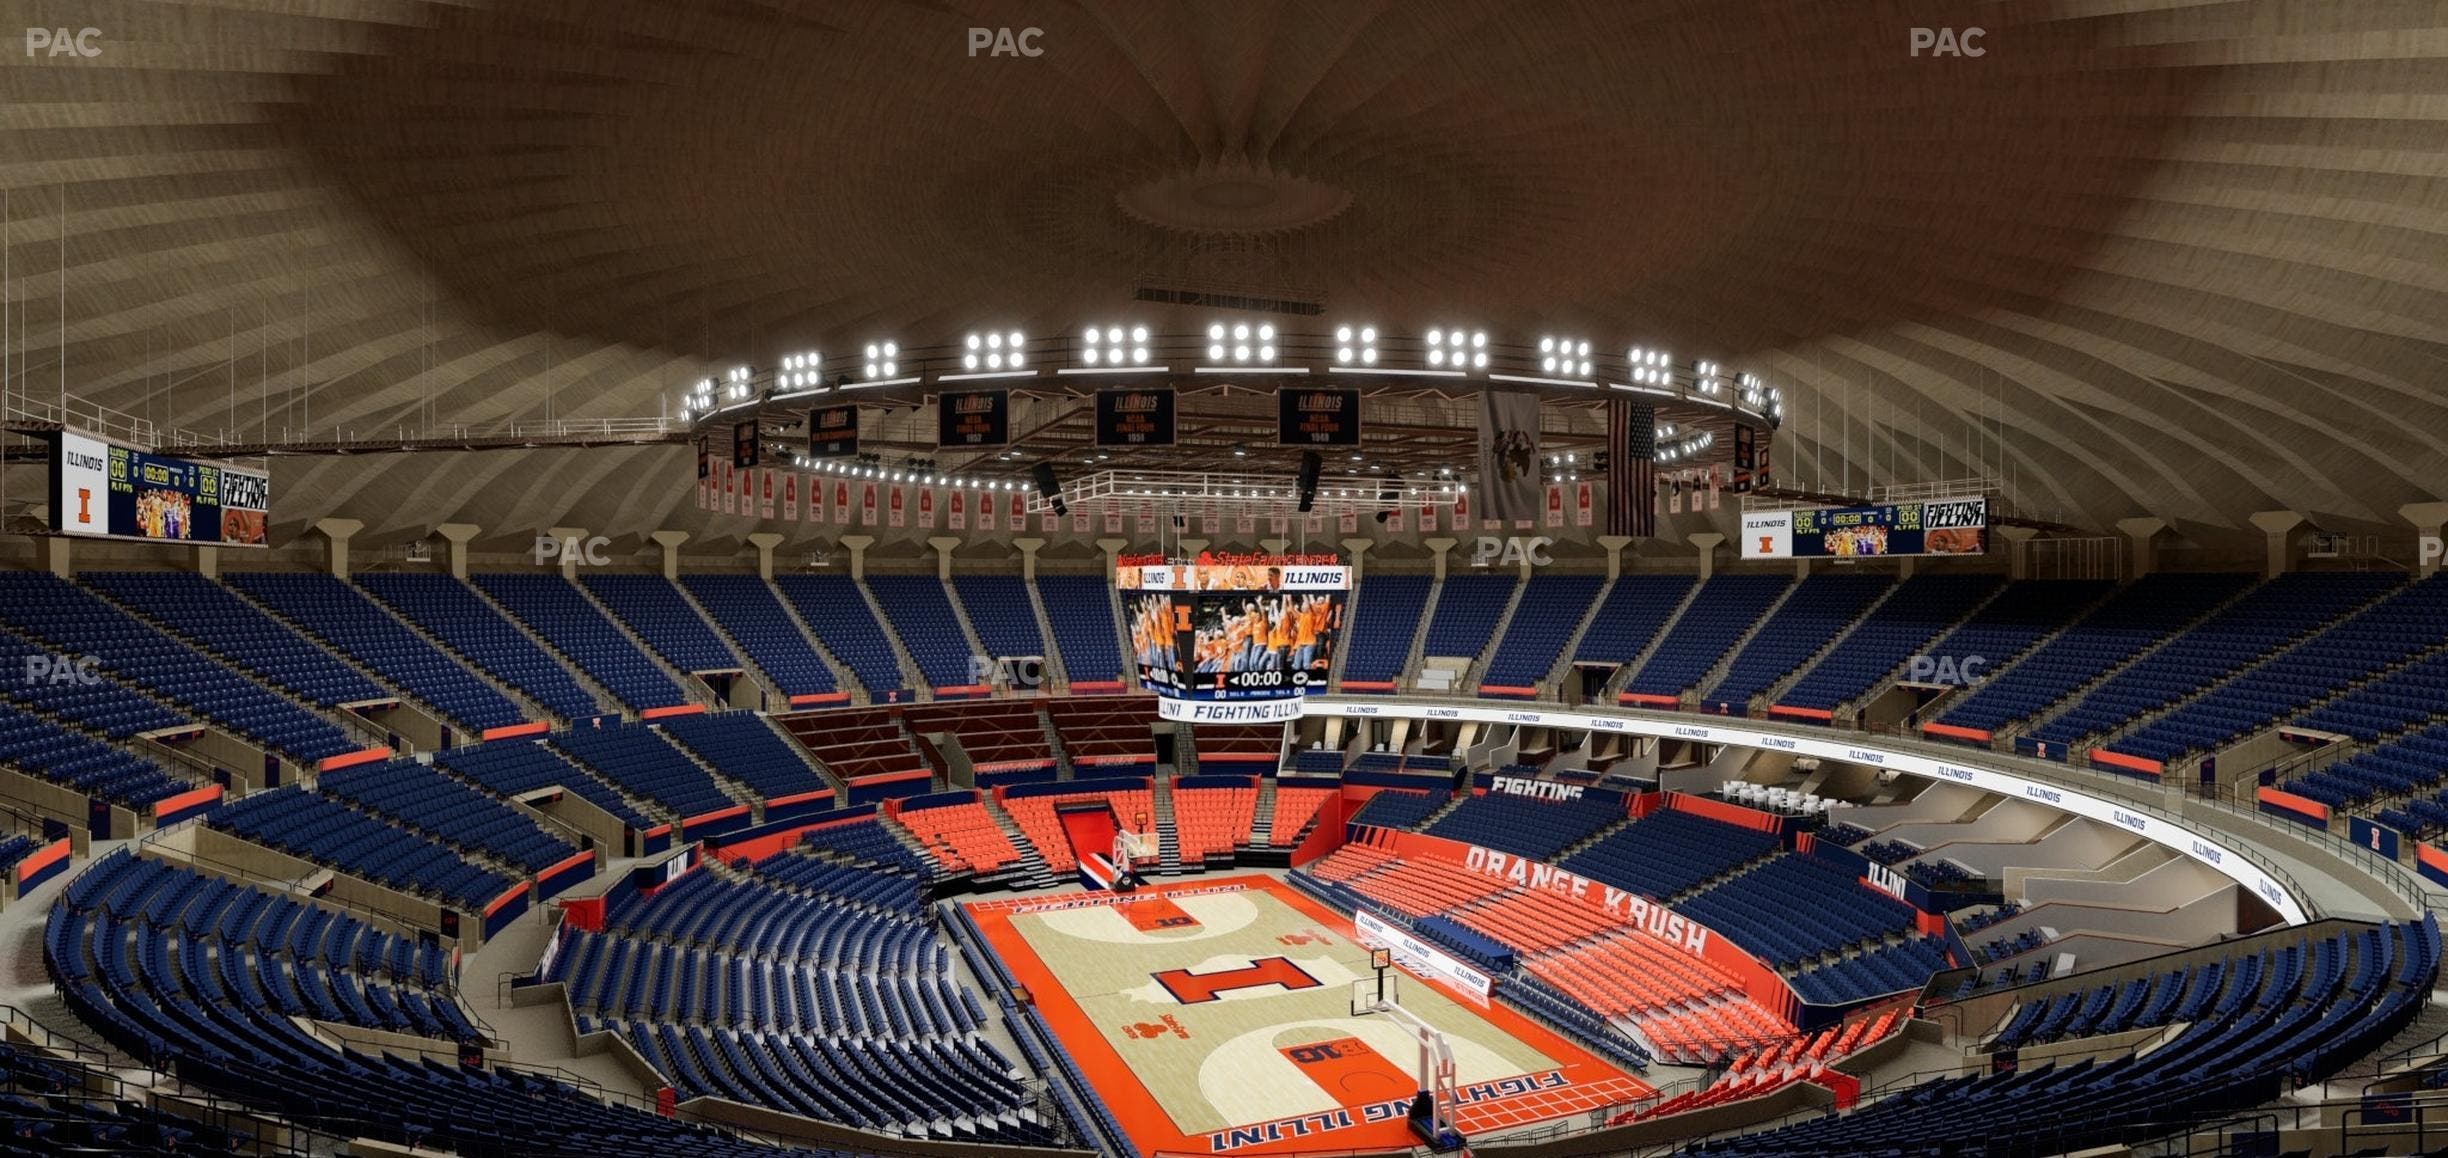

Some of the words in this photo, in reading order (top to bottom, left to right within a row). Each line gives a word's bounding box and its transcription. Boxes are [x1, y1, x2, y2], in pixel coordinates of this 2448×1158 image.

[1114, 396, 1157, 408] ILLINOIS
[1298, 396, 1342, 408] ILLINOIS
[66, 451, 104, 472] ILLINOIS
[111, 459, 125, 479] 00
[145, 466, 168, 483] 00:00
[202, 477, 216, 493] 00
[224, 472, 267, 494] FIGHTING
[78, 488, 90, 523] I
[223, 489, 267, 509] ILLINI
[1928, 501, 1984, 516] FIGHTING
[1746, 520, 1787, 529] ILLINOIS
[1796, 517, 1811, 528] 00
[1835, 514, 1860, 524] 00:00
[1901, 512, 1918, 522] 00
[1926, 513, 1984, 528] ILLINI
[1759, 537, 1773, 553] I
[1284, 572, 1342, 584] ILLINOIS
[1175, 605, 1192, 631] I
[1240, 671, 1282, 687] 00:00
[1214, 689, 1226, 699] 00
[1293, 687, 1306, 696] 00
[1194, 705, 1270, 720] FIGHTING
[1346, 706, 1379, 714] ILLINOIS
[1426, 709, 1459, 718] ILLINOIS
[1508, 713, 1541, 722] ILLINOIS
[1591, 719, 1624, 729] ILLINOIS
[1675, 727, 1709, 738] ILLINOIS
[1761, 737, 1796, 750] ILLINOIS
[1848, 750, 1884, 764] ILLINOIS
[1937, 765, 1974, 781] ILLINOIS
[1492, 776, 1584, 801] FIGHTING
[2026, 785, 2062, 804] ILLINOIS
[2113, 811, 2146, 831] ILLINOIS
[2371, 827, 2380, 851] I
[2192, 840, 2222, 865] ILLINOIS
[1867, 861, 1907, 901] ILLINI
[2259, 878, 2282, 905] ILLINOIS
[1464, 846, 1589, 899] ORANGE
[1602, 886, 1708, 956] KRUSH
[1402, 939, 1430, 959] ILLINOIS
[1150, 956, 1324, 1005] I
[1453, 966, 1486, 989] ILLINOIS
[1363, 1071, 1571, 1123] FIGHTNG
[1211, 1108, 1353, 1153] ILLINI
